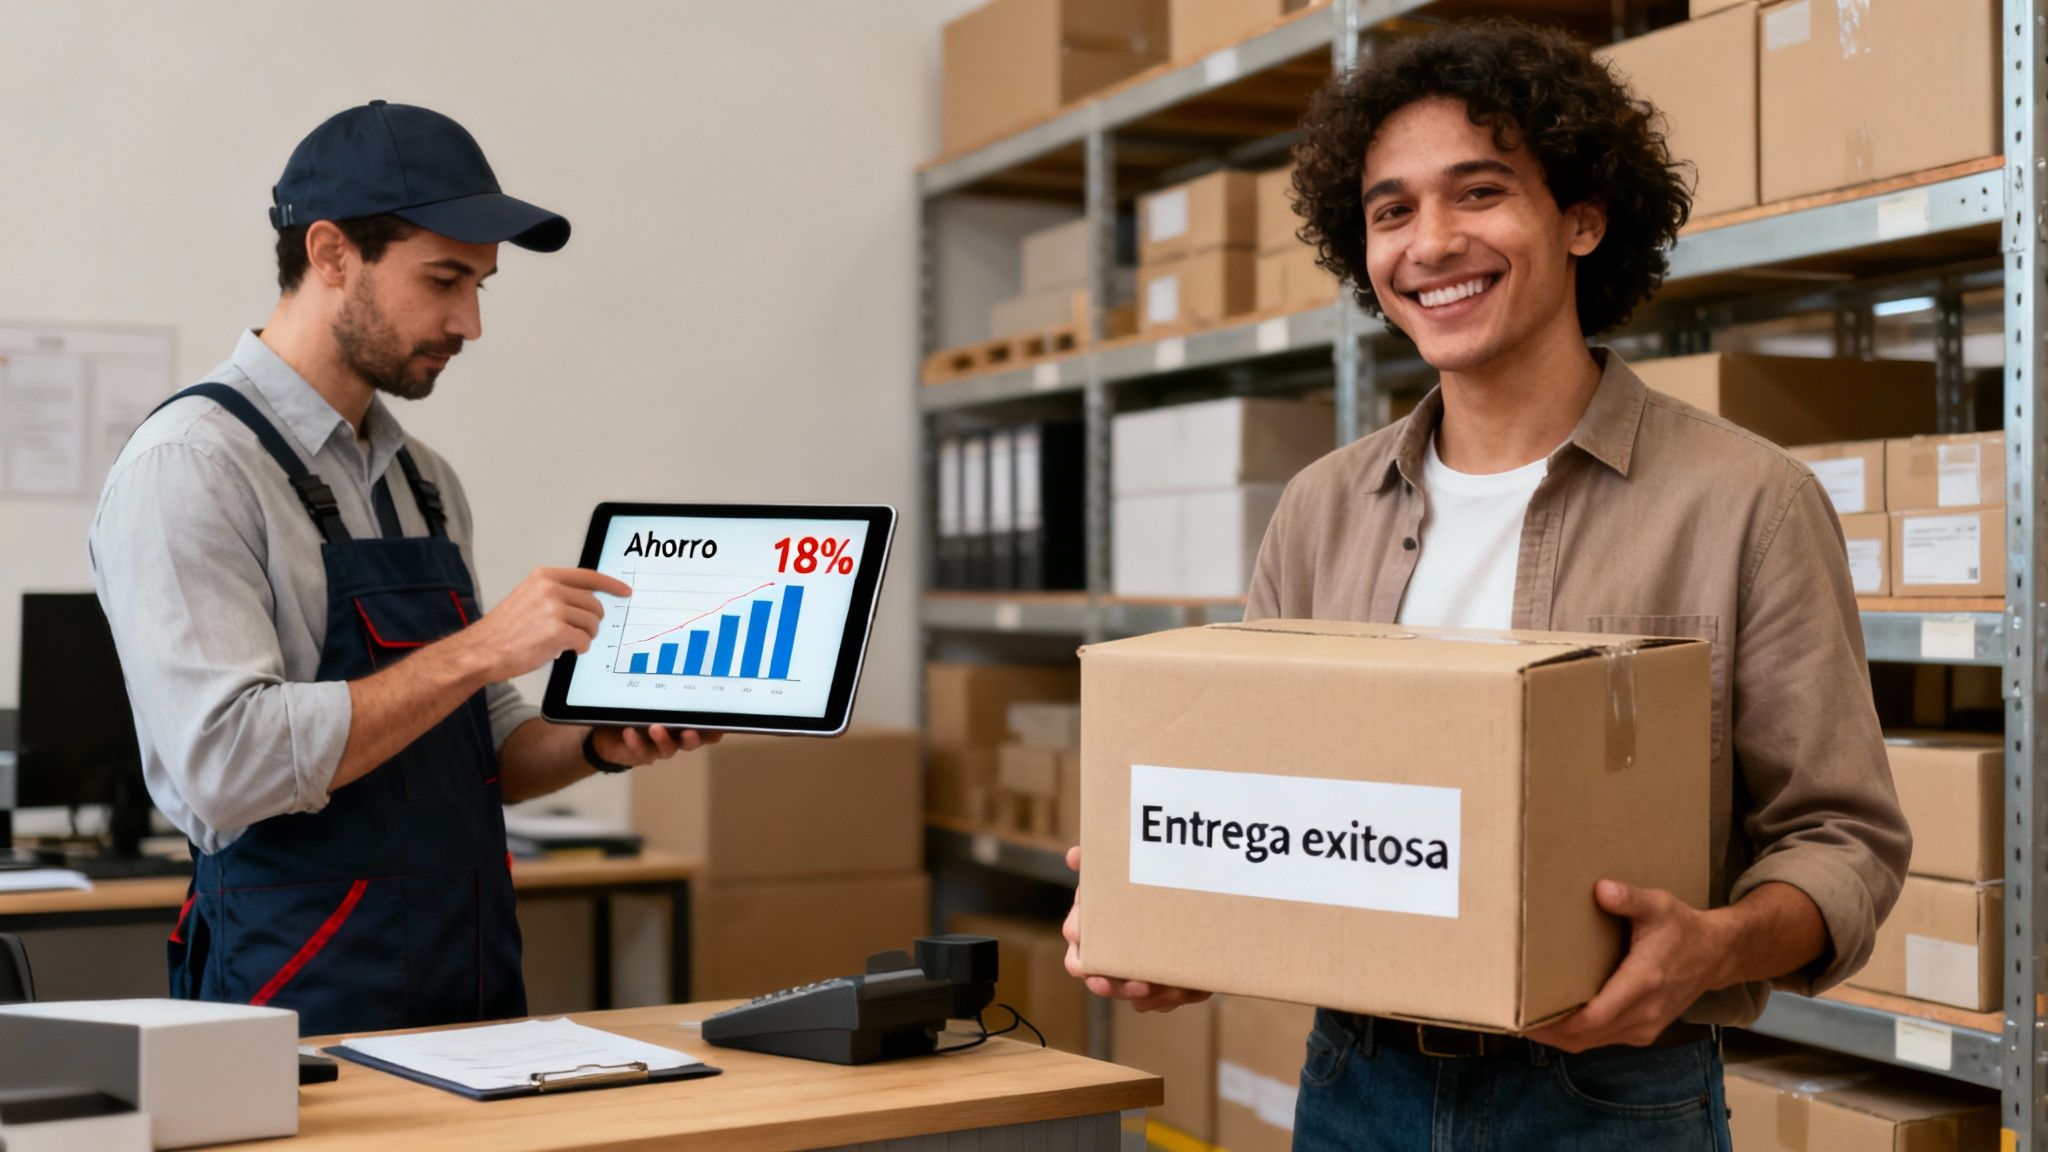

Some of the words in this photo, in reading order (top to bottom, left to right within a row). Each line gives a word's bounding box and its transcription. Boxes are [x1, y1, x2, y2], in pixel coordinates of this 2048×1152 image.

[624, 531, 718, 559] Ahorro
[774, 536, 855, 575] 18%
[1142, 805, 1290, 863] Entrega
[1302, 820, 1449, 870] exitosa
